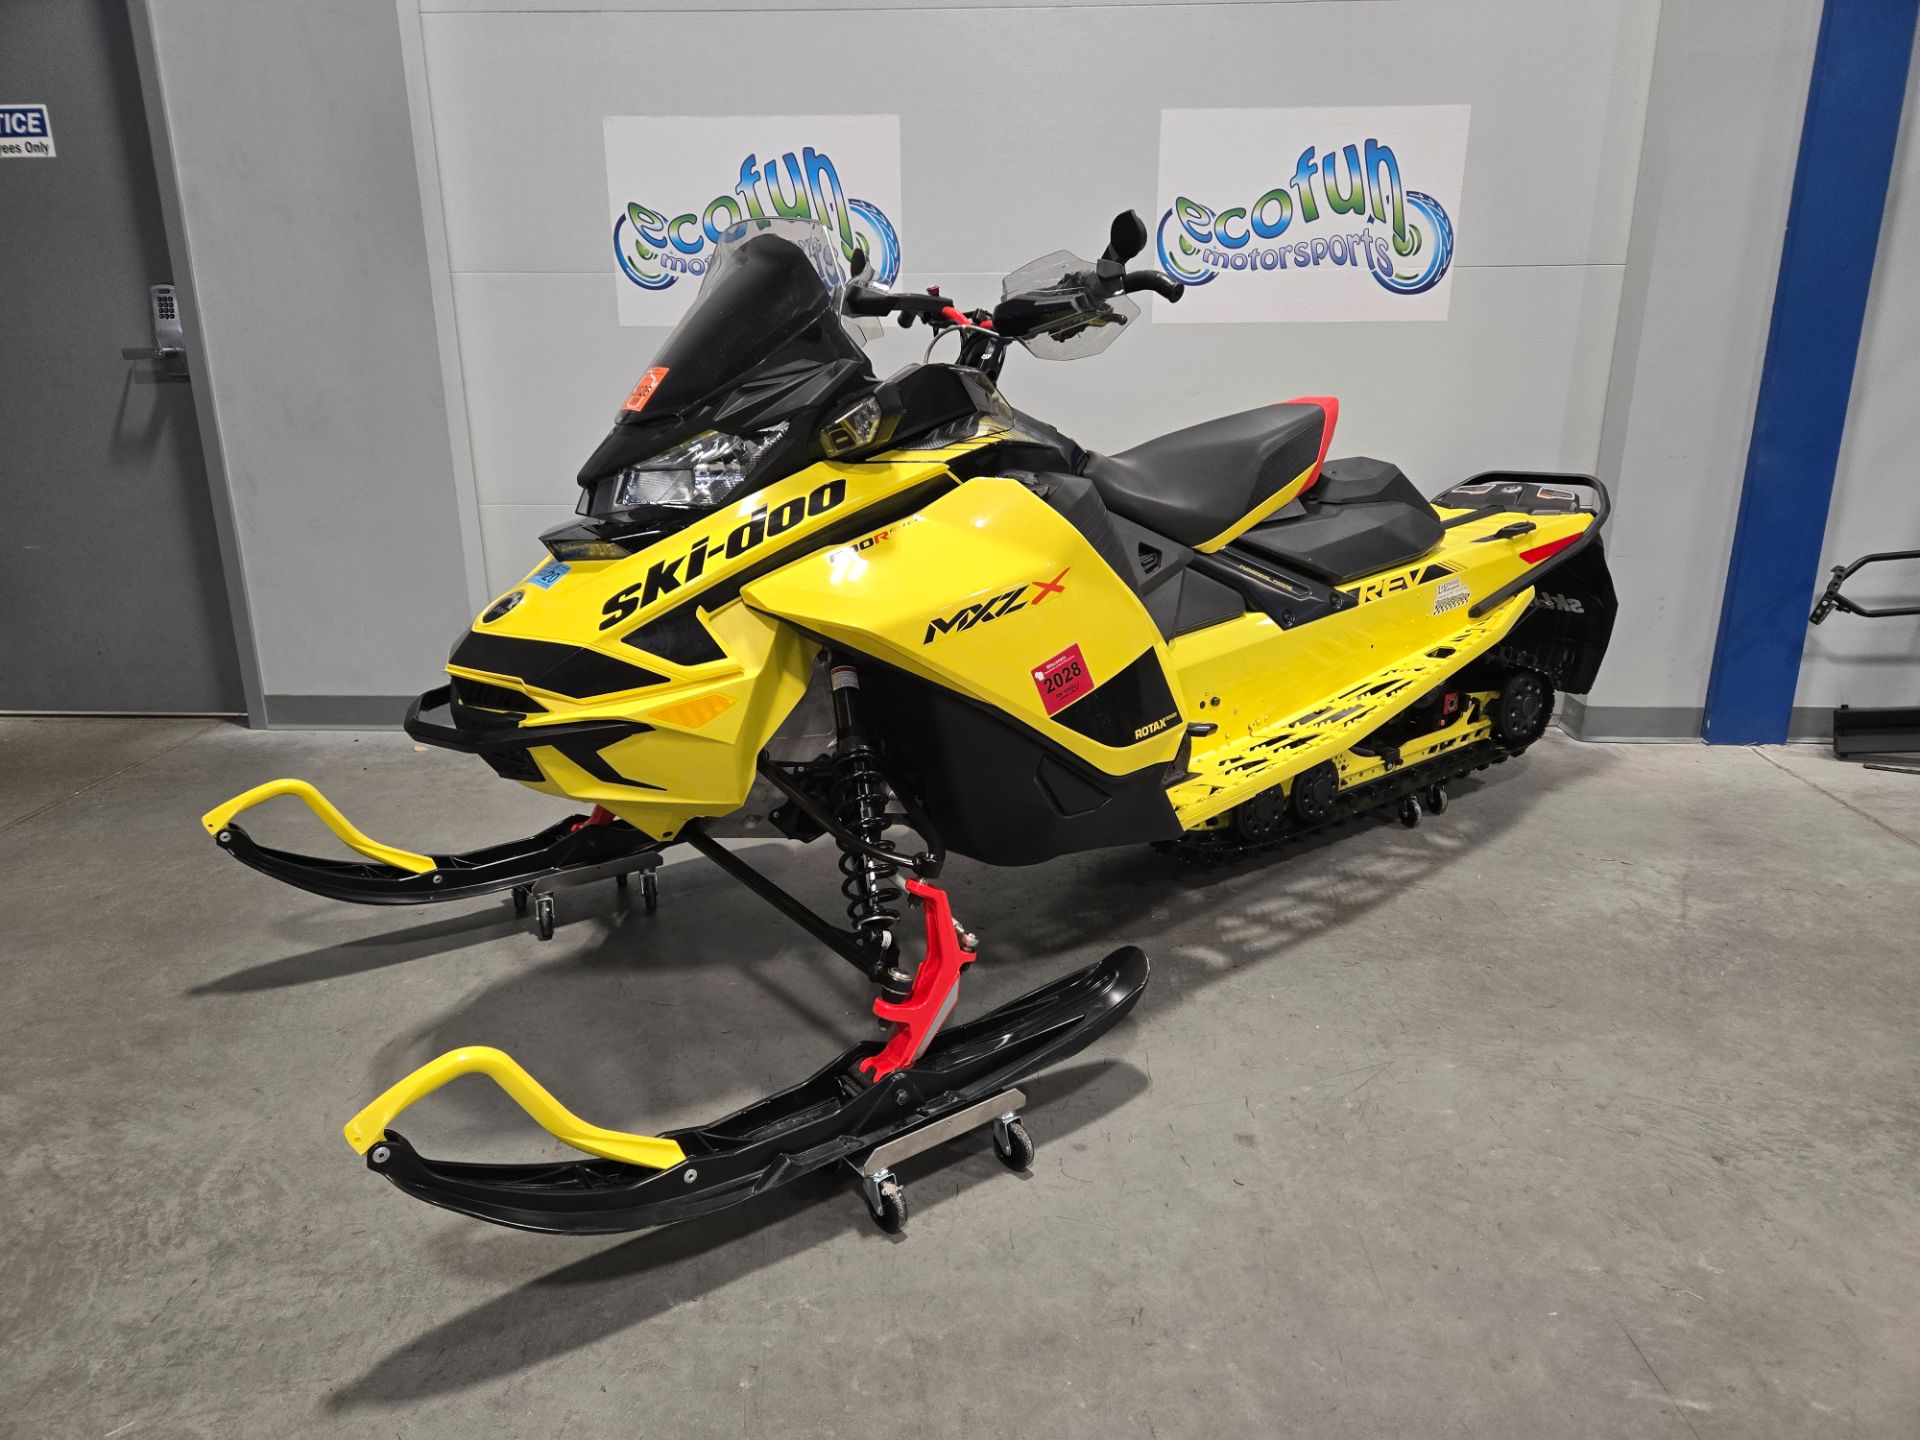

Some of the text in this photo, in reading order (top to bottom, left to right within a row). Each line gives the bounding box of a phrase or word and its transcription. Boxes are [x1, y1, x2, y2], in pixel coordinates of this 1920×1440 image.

[25, 141, 49, 156] Only
[1202, 228, 1394, 277] motorsports
[1043, 661, 1082, 694] 2028
[1134, 717, 1167, 740] ROTAX
